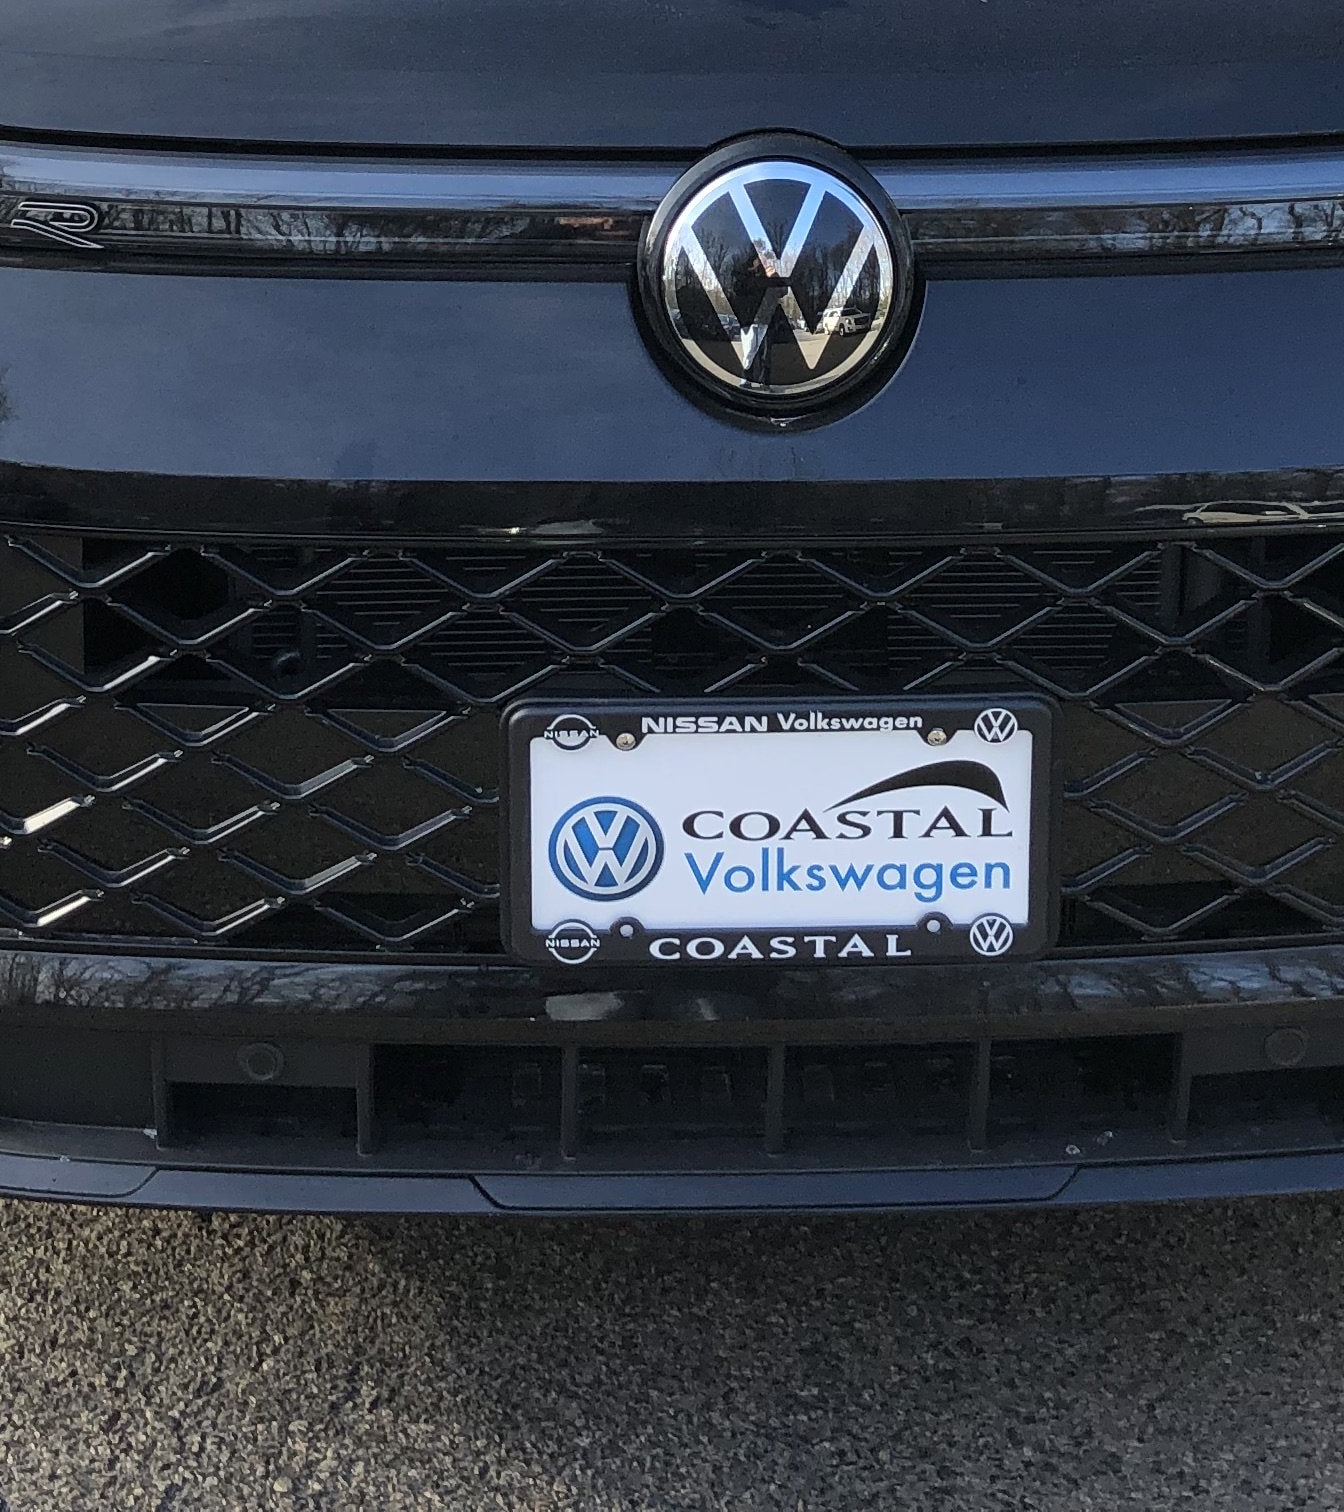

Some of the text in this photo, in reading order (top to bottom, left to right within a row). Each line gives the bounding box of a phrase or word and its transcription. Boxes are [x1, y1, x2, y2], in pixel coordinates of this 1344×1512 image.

[544, 729, 599, 738] NISSAN
[641, 711, 923, 733] NISSAN Volkswagen
[682, 806, 1013, 840] COASTAL
[684, 847, 1011, 903] Volkswagen
[545, 939, 600, 948] NISSAN
[649, 934, 911, 960] COASTAL
